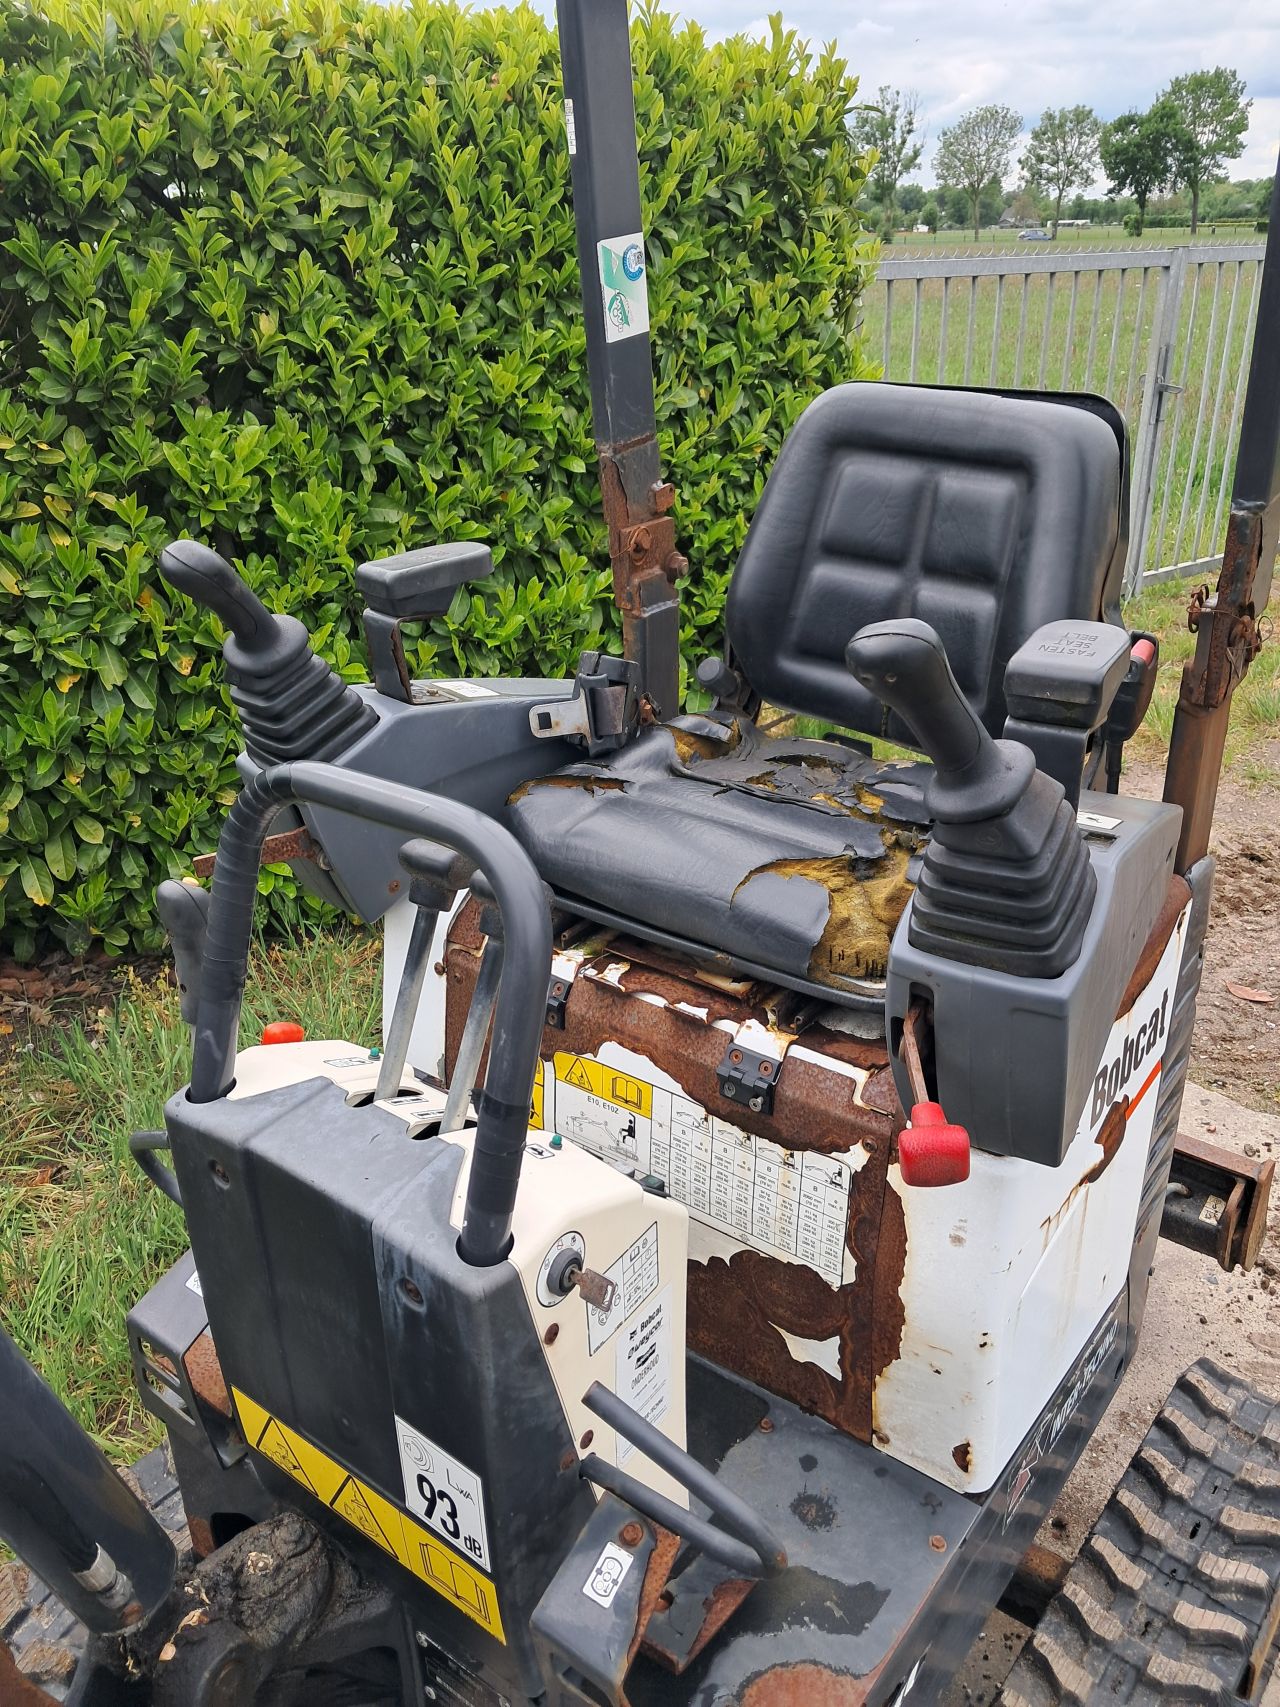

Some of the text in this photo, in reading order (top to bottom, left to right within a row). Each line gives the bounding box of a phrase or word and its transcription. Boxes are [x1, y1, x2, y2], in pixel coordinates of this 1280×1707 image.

[1061, 632, 1099, 641] BELT
[1038, 644, 1096, 657] FASTEN
[1053, 639, 1092, 649] SEAT
[1090, 987, 1168, 1131] Bobcat
[416, 1473, 482, 1559] 93 dB
